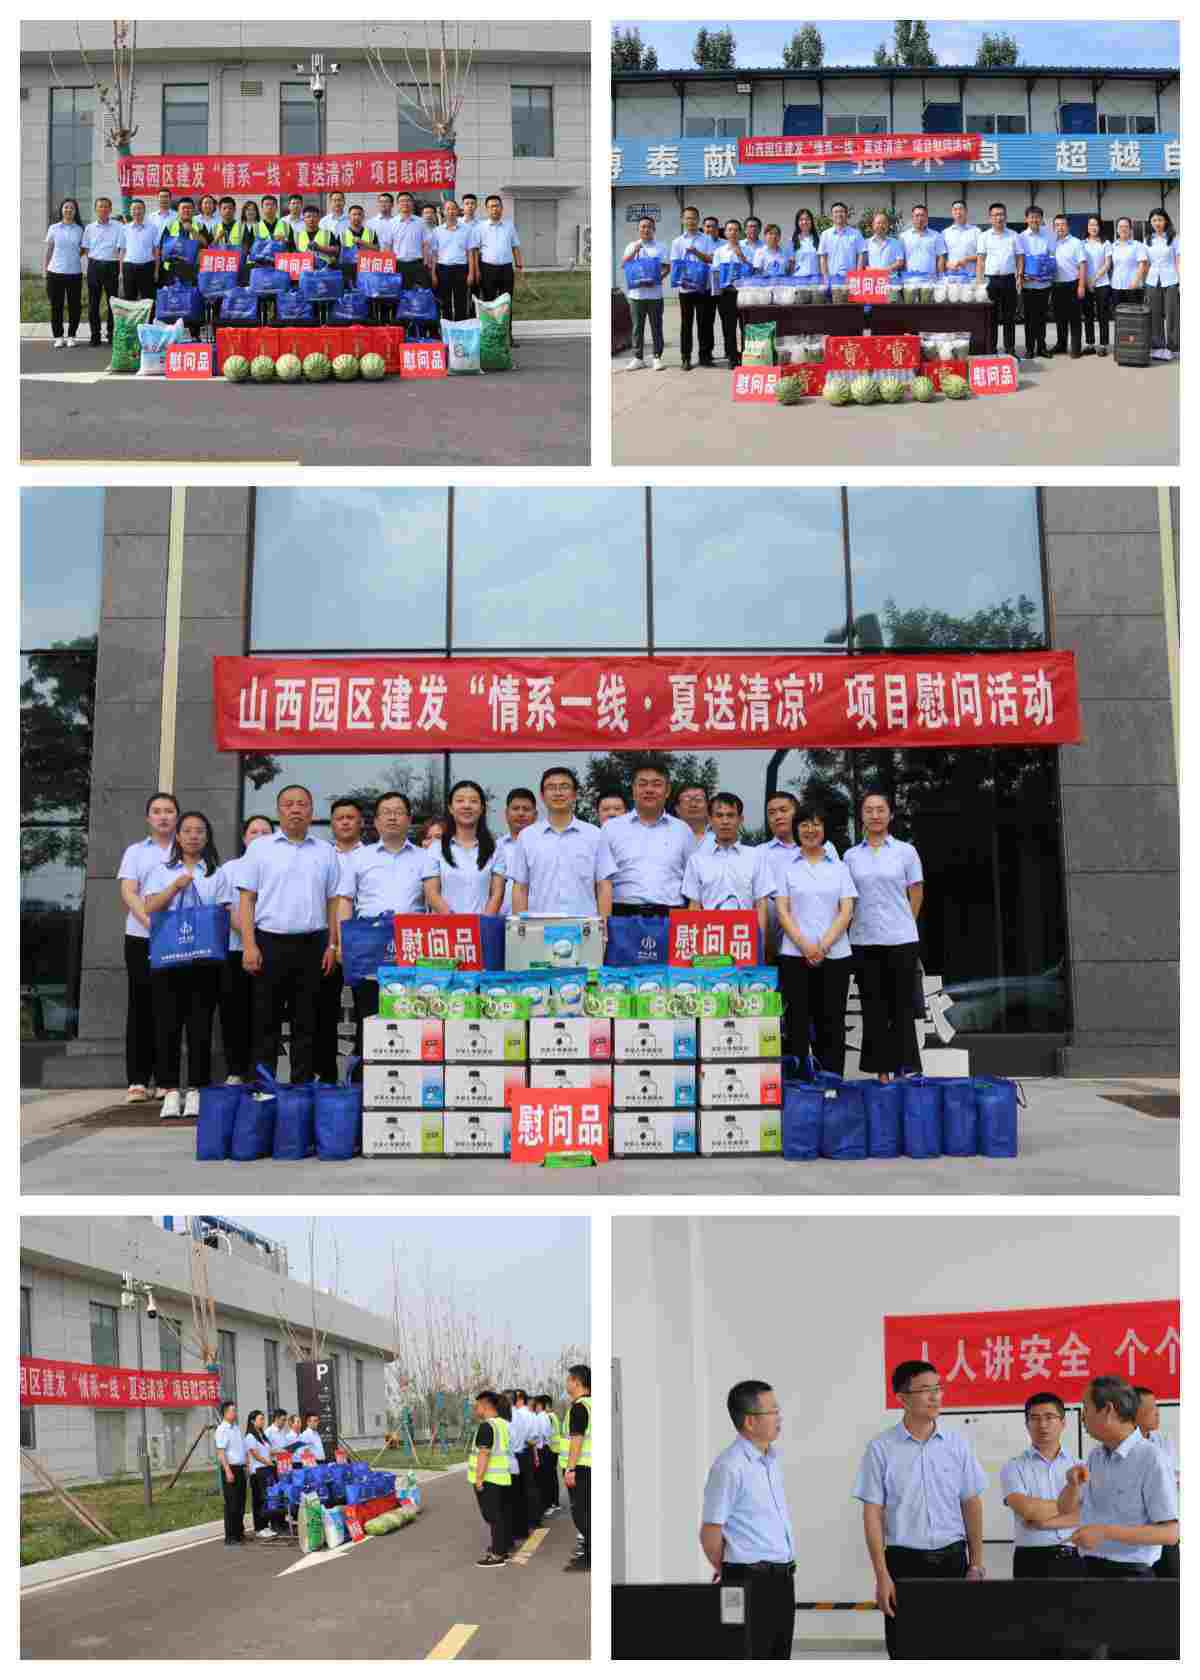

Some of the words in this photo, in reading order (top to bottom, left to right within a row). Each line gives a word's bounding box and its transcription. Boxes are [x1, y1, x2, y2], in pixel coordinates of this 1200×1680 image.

[238, 670, 1056, 734] 山西园区建发“情系一线·夏送清凉”项目慰问活动
[401, 927, 477, 964] 慰问品
[671, 922, 752, 961] 慰问品
[518, 1103, 603, 1147] 慰问品
[316, 1363, 329, 1380] P
